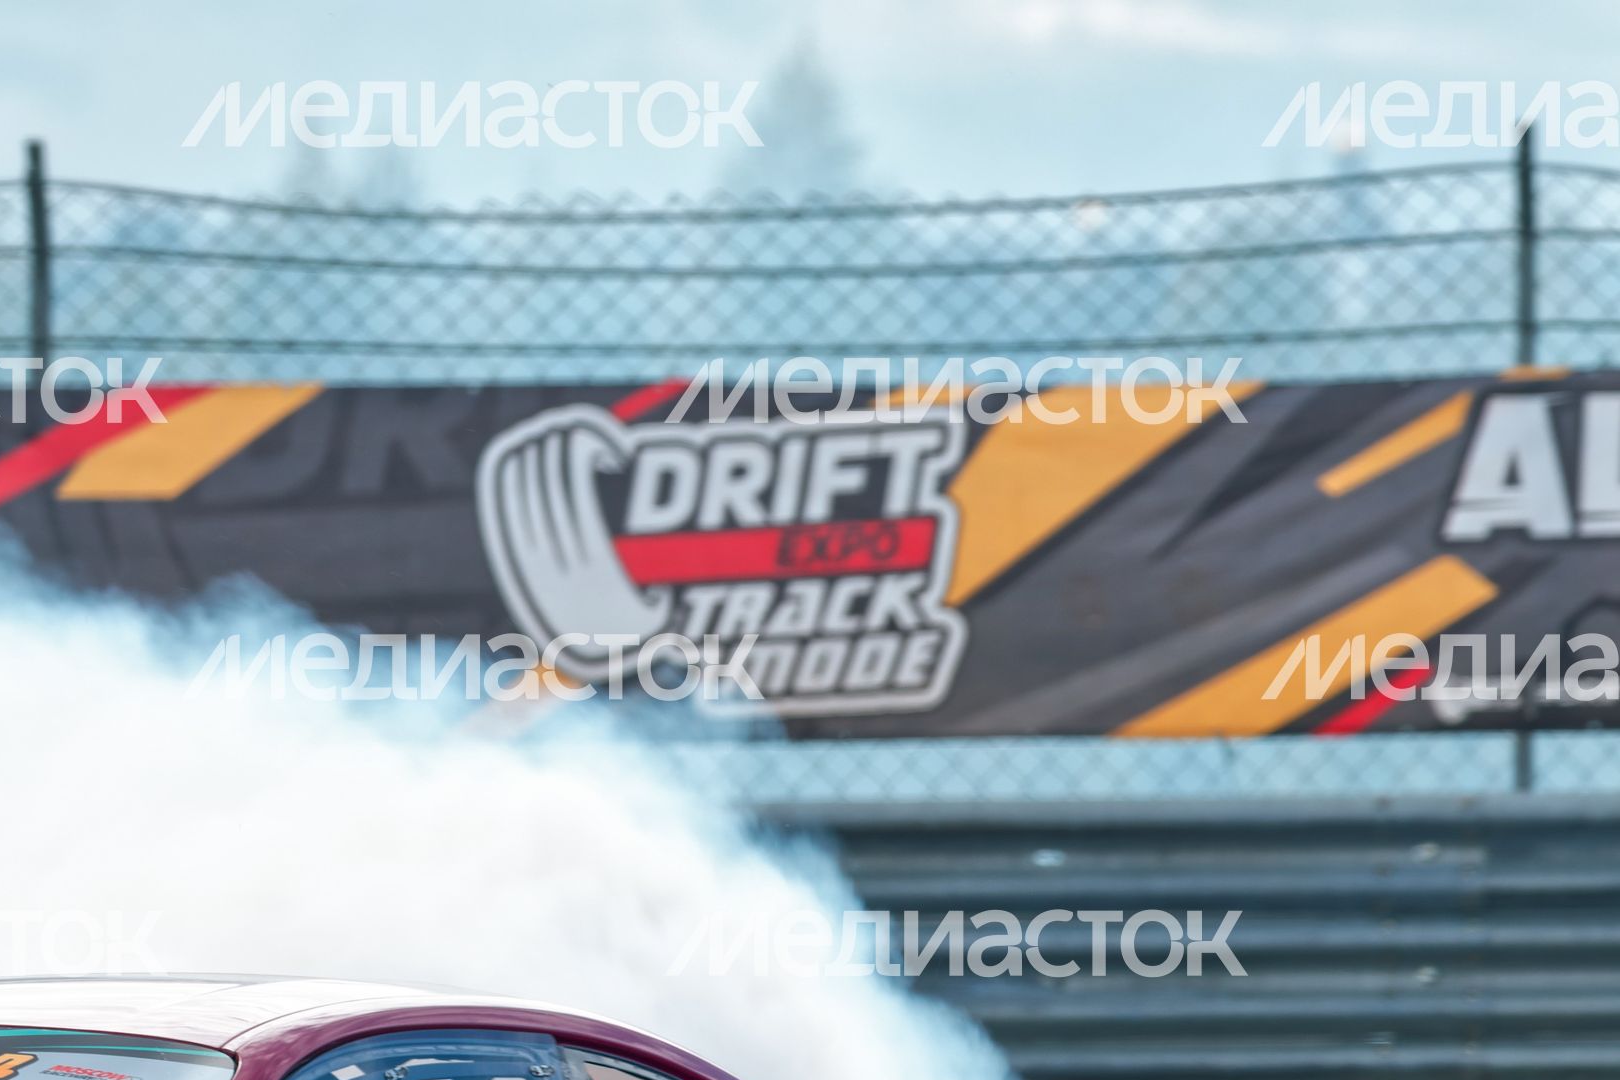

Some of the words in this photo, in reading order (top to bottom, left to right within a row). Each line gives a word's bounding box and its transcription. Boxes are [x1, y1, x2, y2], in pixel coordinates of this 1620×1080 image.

[624, 430, 942, 533] DRIFT
[776, 522, 899, 568] EXPO
[682, 573, 927, 641] TRACK
[49, 1065, 126, 1080] MOSCOW
